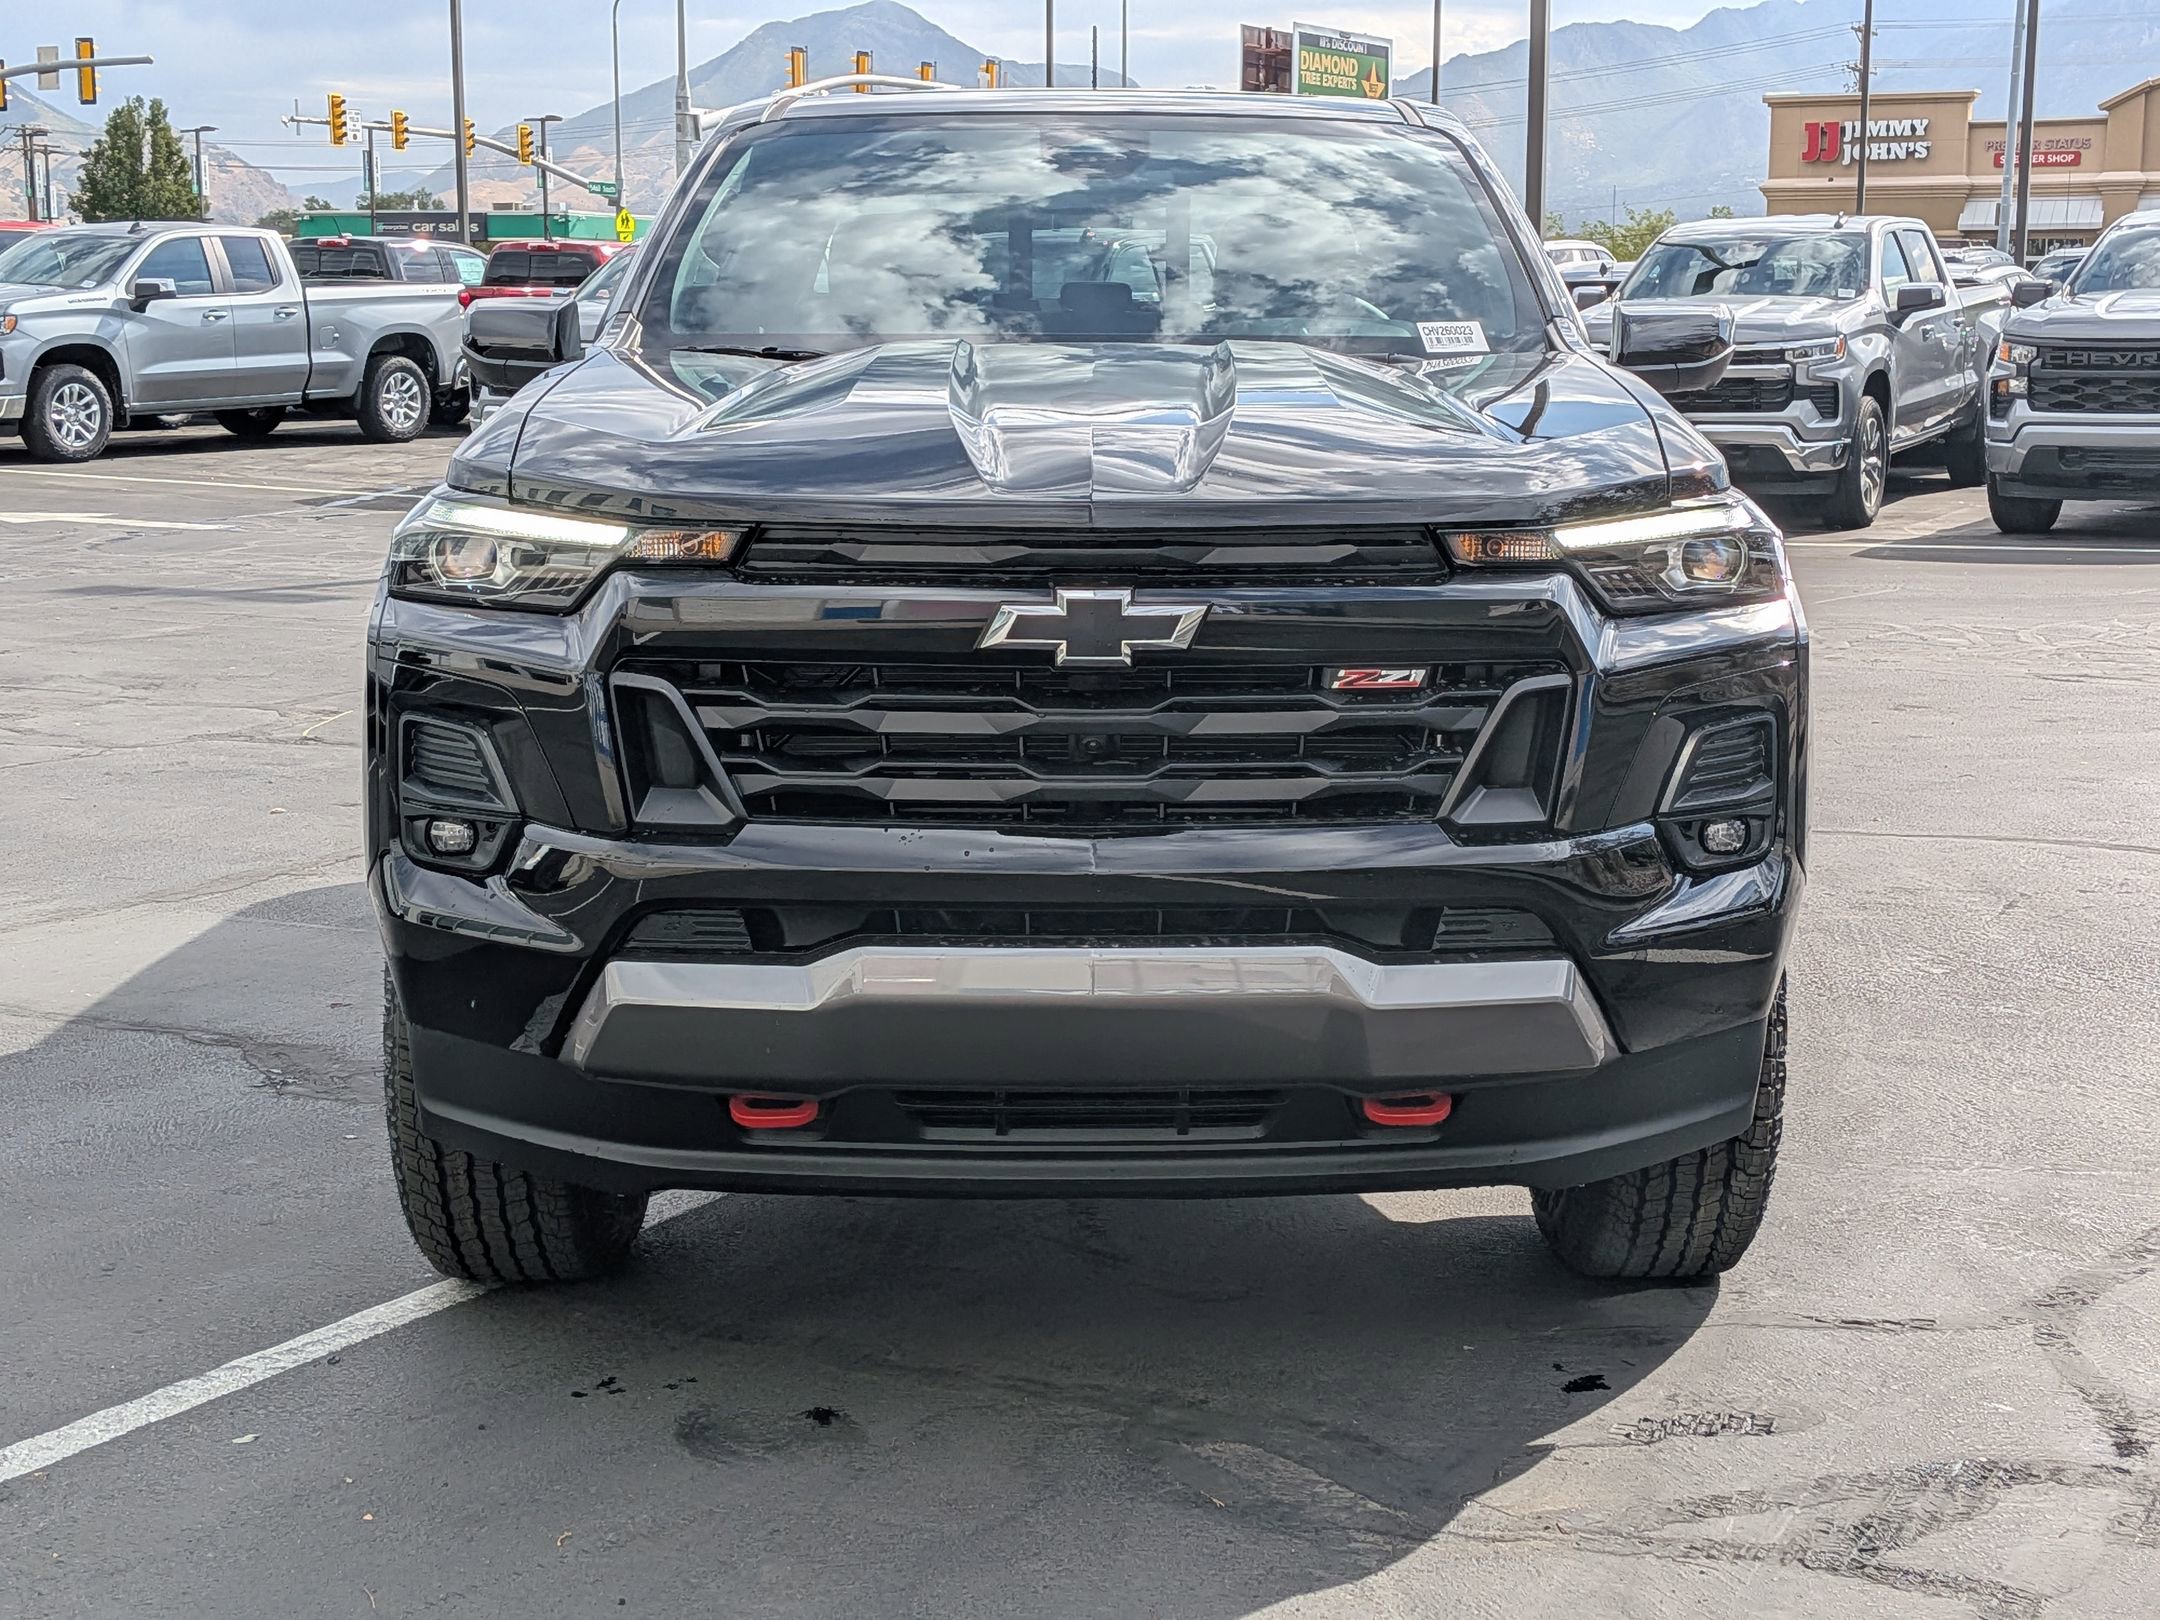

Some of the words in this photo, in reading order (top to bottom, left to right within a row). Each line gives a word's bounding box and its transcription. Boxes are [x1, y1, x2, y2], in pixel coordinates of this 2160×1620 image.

[1301, 50, 1359, 77] DIAMOND
[1301, 71, 1321, 86] TREE
[1322, 74, 1357, 91] EXPERTS
[1843, 118, 1929, 142] JIMMY
[1802, 121, 1841, 162] JJ
[2044, 138, 2092, 151] STATUS
[1842, 141, 1929, 166] JOHN'S
[1999, 155, 2045, 165] SEER
[2047, 153, 2075, 164] SHOP
[412, 223, 436, 232] car
[438, 219, 479, 232] sals
[1422, 326, 1474, 337] CHV260023
